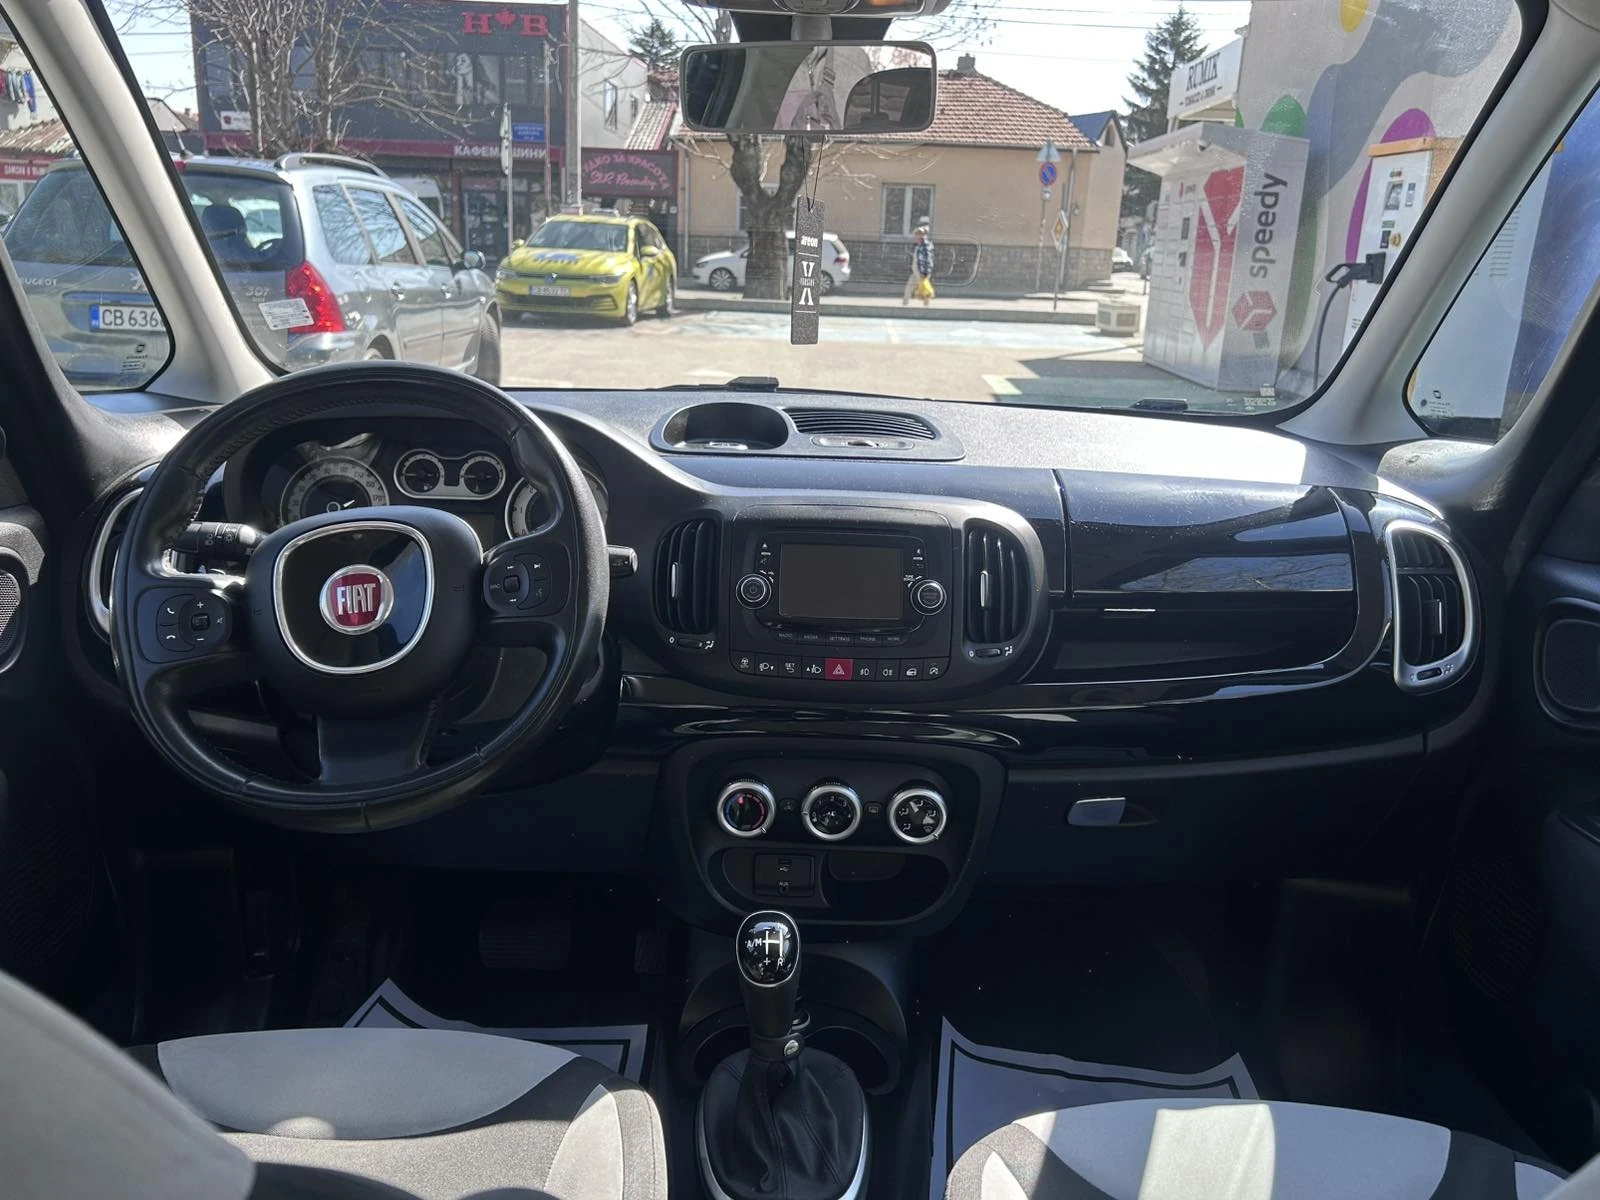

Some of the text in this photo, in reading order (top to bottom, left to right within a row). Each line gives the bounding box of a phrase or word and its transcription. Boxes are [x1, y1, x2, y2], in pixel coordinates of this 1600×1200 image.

[454, 145, 547, 159] КАФЕМШИНИ
[1250, 173, 1288, 279] speedy
[800, 235, 819, 248] areon
[19, 277, 57, 287] EUGEOT
[102, 309, 125, 327] CB
[336, 583, 377, 616] FIAT
[777, 957, 784, 968] R
